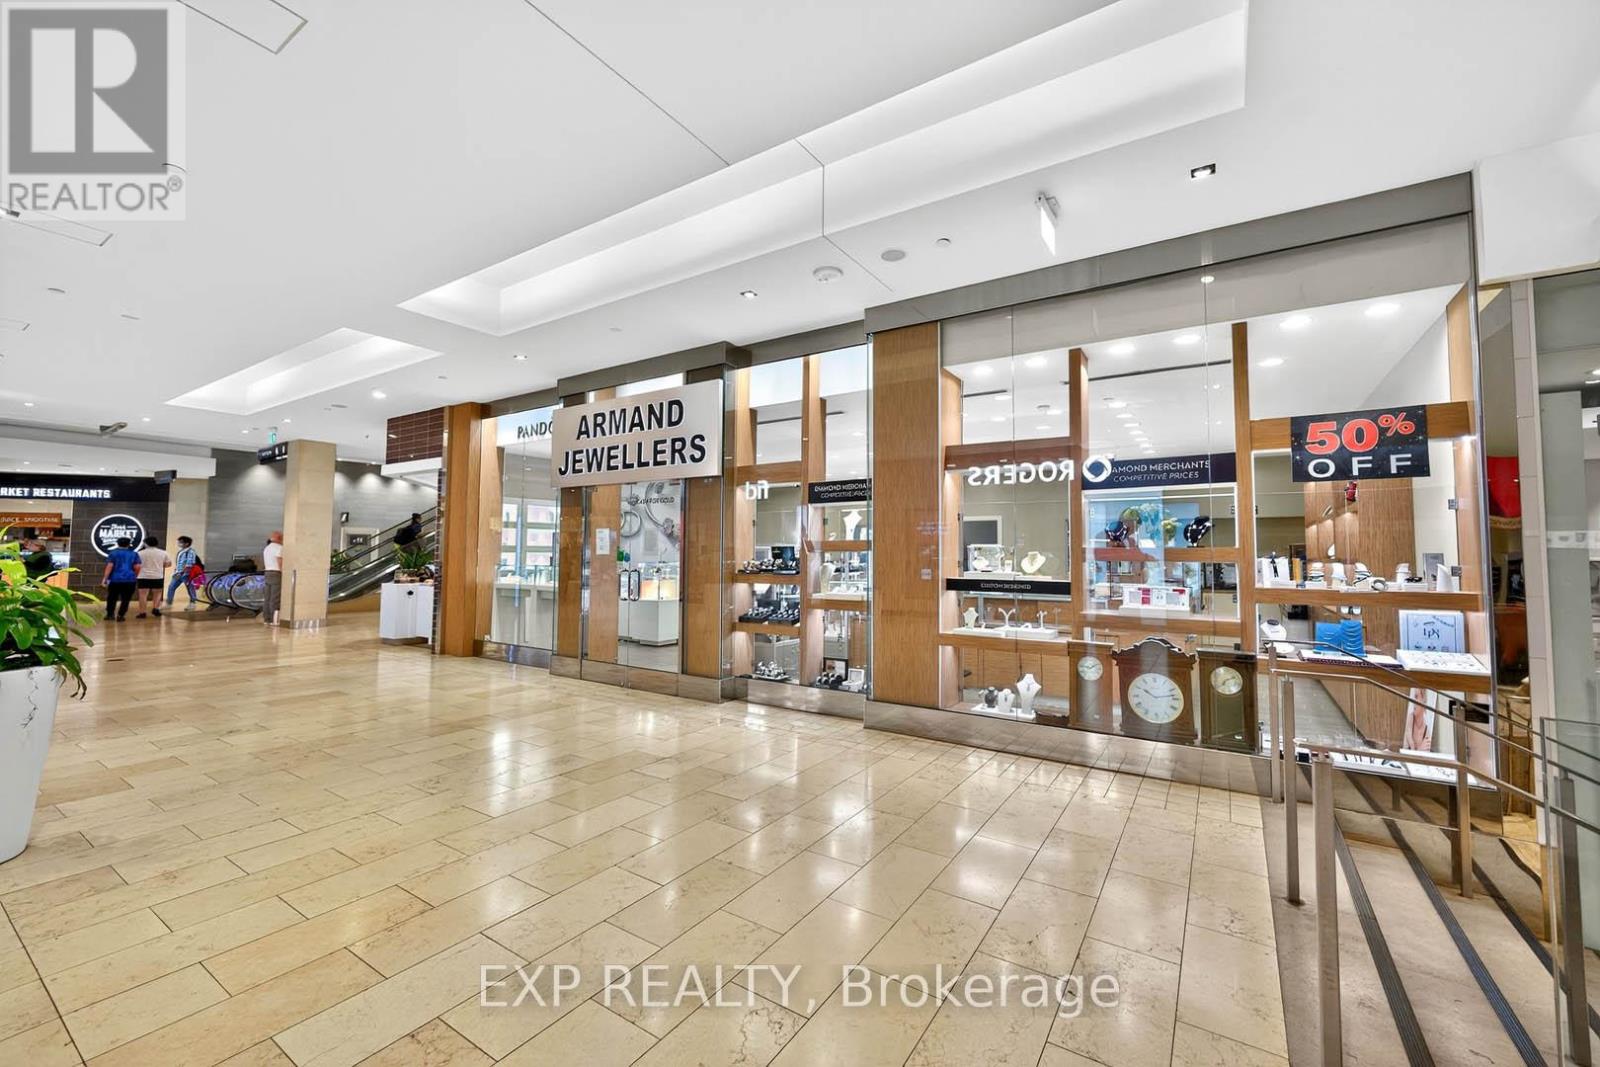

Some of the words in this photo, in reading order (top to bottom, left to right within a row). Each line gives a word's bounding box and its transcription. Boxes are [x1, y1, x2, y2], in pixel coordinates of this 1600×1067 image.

[576, 399, 684, 440] ARMAND
[1305, 412, 1416, 455] 50%
[558, 434, 706, 476] JEWELLERS
[1150, 460, 1210, 471] MERCHANTS
[1308, 453, 1412, 478] OFF
[1113, 473, 1167, 482] COMPETITIVE
[1169, 471, 1199, 479] PRICES
[33, 488, 112, 498] RESTAURANTS
[99, 529, 138, 538] MARKET
